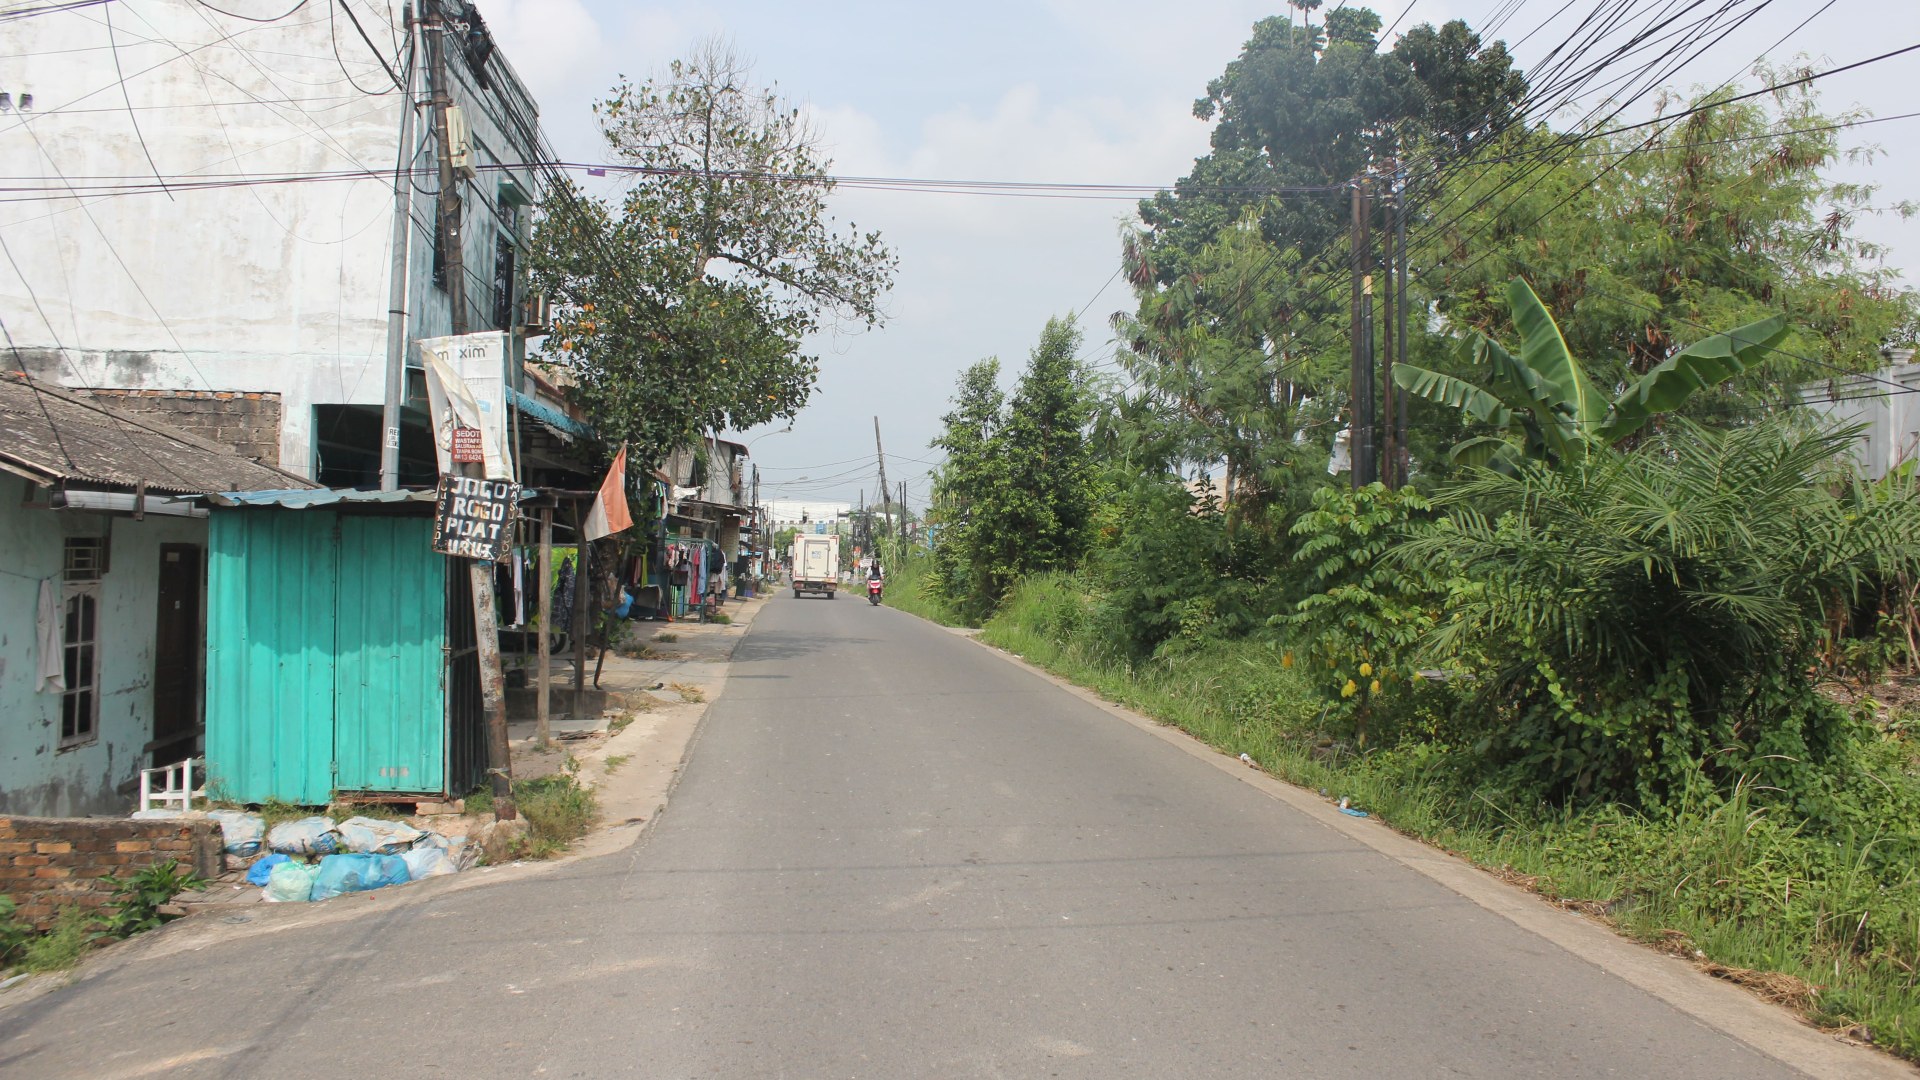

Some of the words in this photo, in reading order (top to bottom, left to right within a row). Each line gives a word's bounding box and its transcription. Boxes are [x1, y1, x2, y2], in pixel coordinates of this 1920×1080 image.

[437, 344, 486, 360] mxim
[456, 430, 480, 438] SEDOT
[450, 476, 508, 499] JOGO
[452, 497, 504, 521] ROGO
[445, 517, 500, 539] PIJAT
